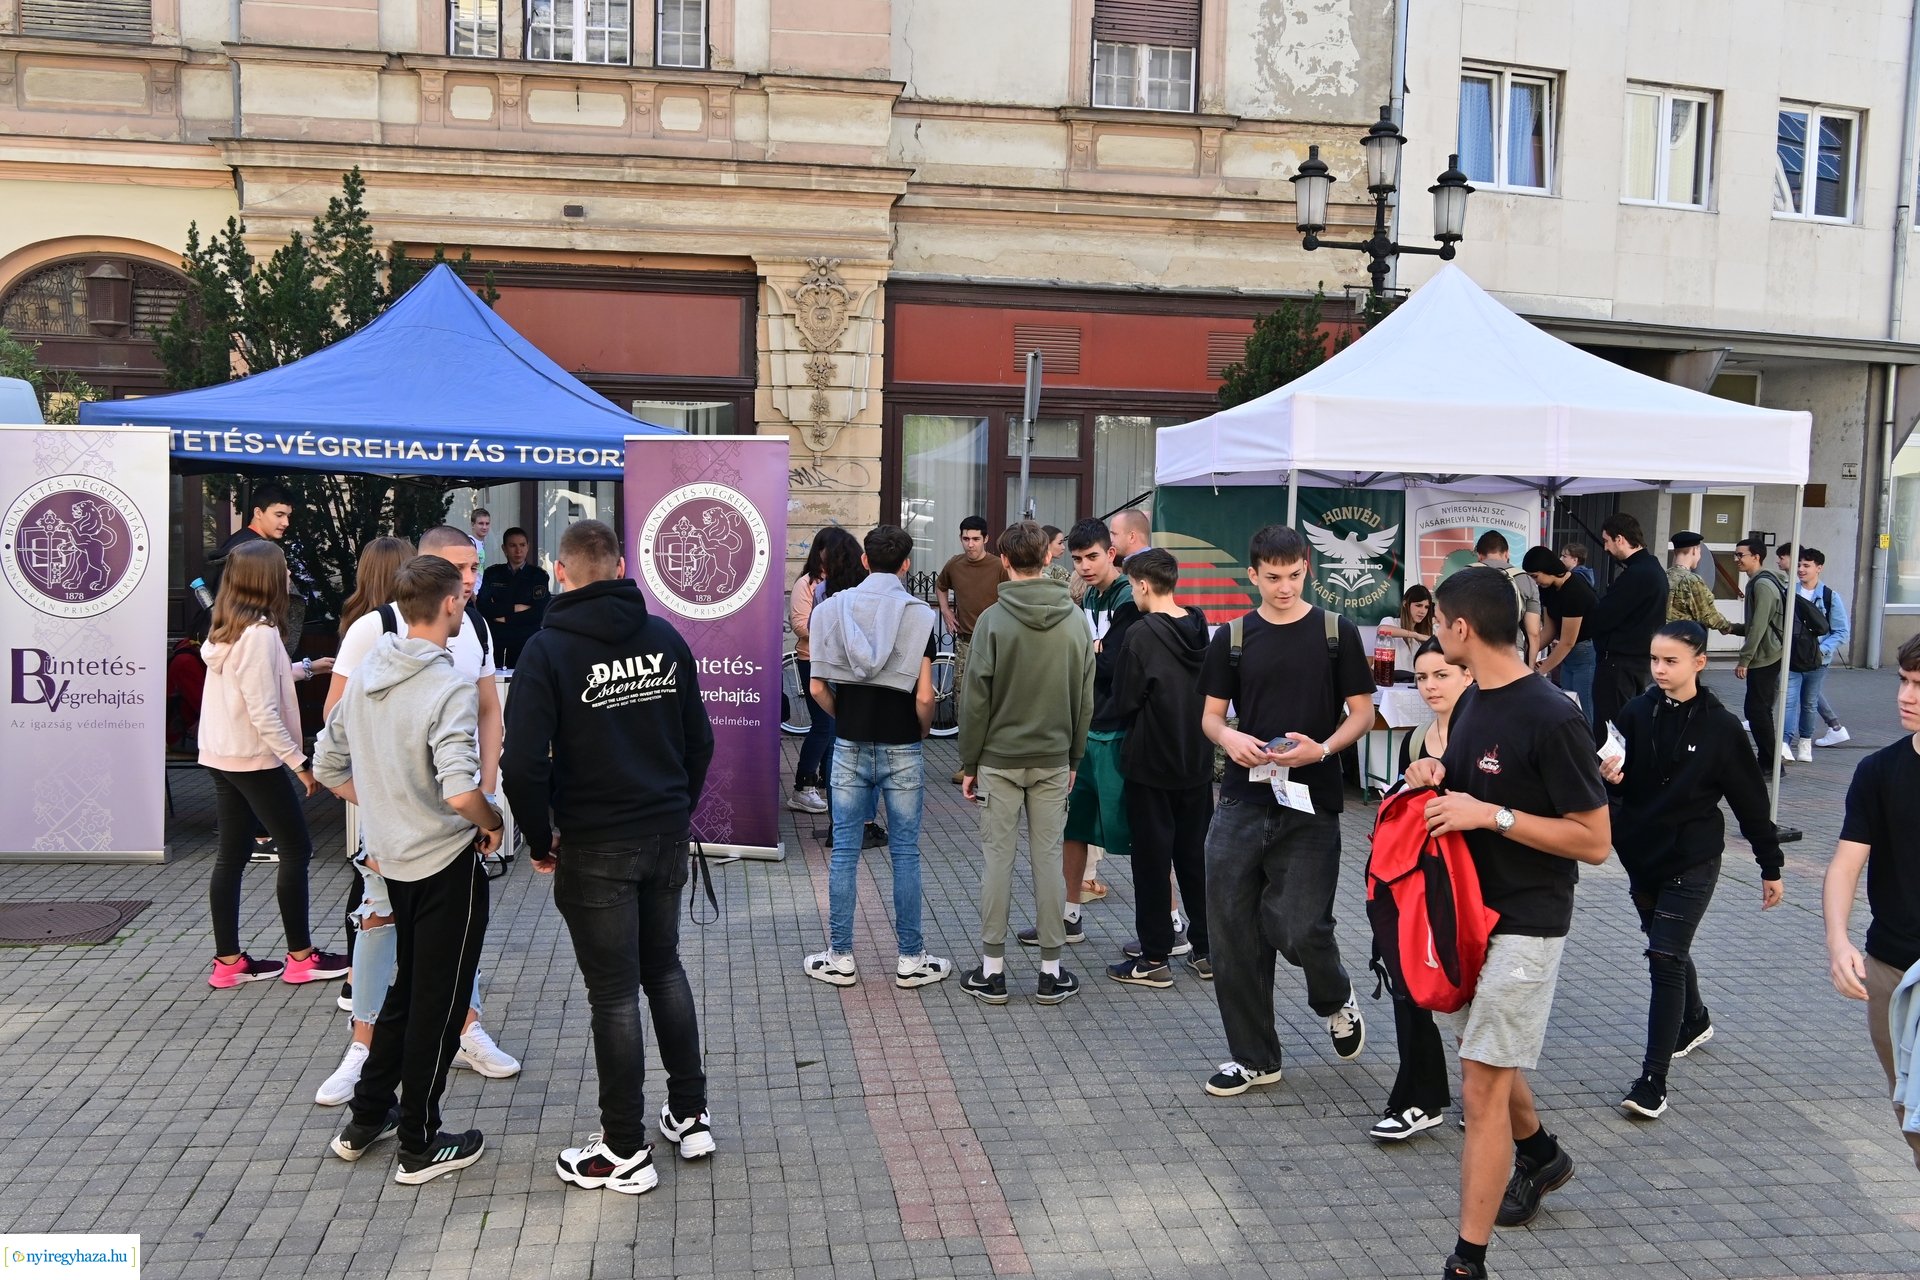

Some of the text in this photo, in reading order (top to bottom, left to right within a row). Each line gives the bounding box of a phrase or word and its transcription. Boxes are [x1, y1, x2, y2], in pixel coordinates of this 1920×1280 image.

[169, 427, 624, 467] TETÉS-VÉGREHAJTÁS TOBOR
[5, 479, 144, 540] BÜNTETÉS-VÉGREHAJTÁS
[644, 486, 765, 545] BÜNTETÉS-VÉGREHAJTÁS
[1321, 506, 1381, 528] HONVÉD
[1419, 515, 1527, 531] VÁSÁRHELYI PÁL TECHNIKUM
[1441, 505, 1505, 516] NYÍREGYHÁZI SZC
[5, 556, 144, 614] HUNGARIAN PRISON SERVICE
[65, 592, 85, 600] 1878
[644, 560, 764, 616] HUNGARIAN PRISON SERVICE
[695, 594, 712, 602] 1878
[1311, 579, 1391, 609] KADÉT PROGRAM
[11, 648, 146, 704] Büntetés-
[591, 652, 664, 684] DAILY
[695, 655, 762, 675] tetés-
[36, 680, 145, 713] Végrehajtás
[581, 661, 677, 703] Essentials
[700, 686, 760, 707] rehajtás
[10, 719, 145, 732] Az igazság védelmében
[708, 716, 760, 727] delmében
